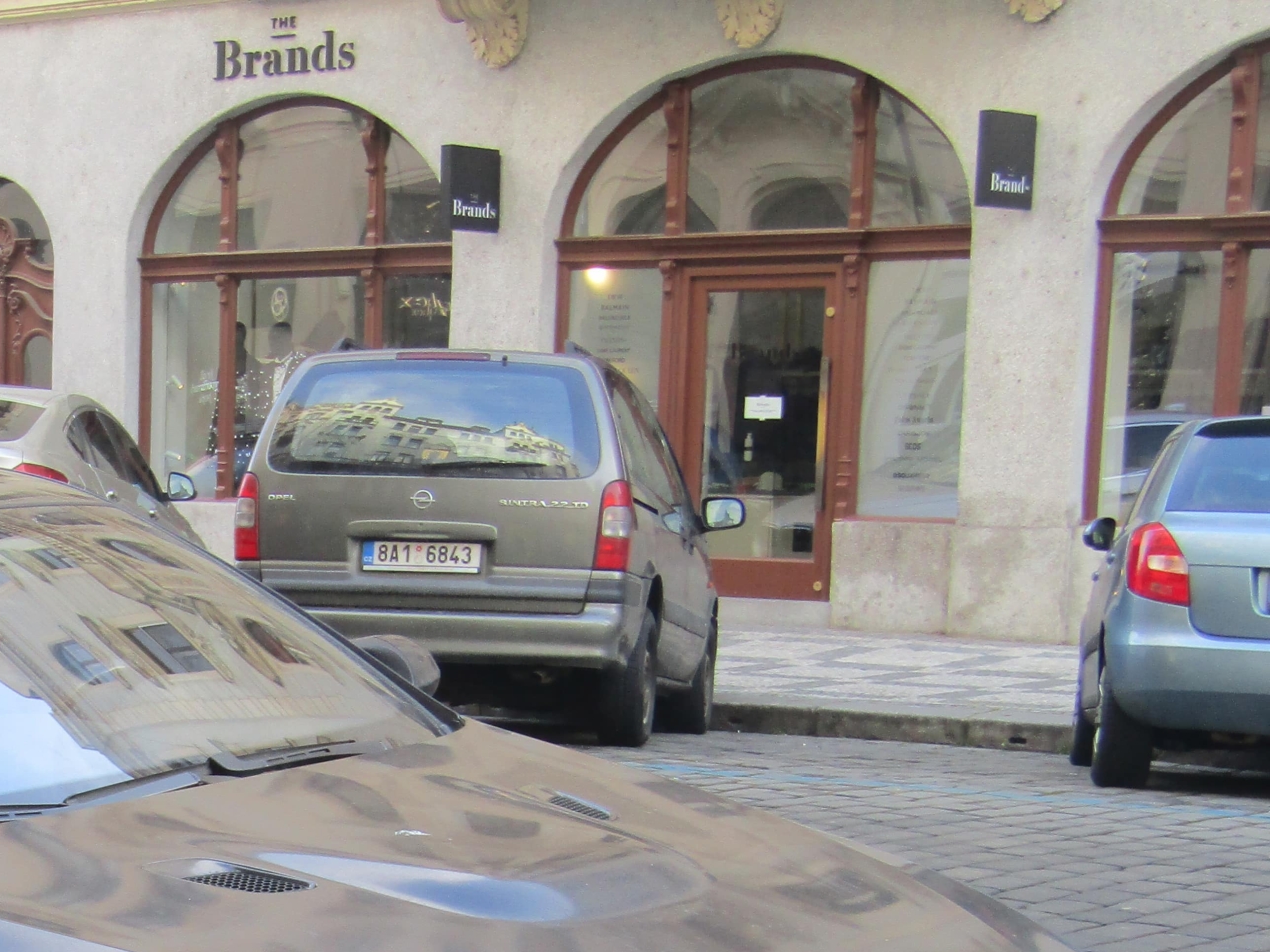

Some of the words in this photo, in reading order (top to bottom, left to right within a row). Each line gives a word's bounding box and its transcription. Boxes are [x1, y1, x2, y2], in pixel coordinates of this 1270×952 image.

[270, 16, 297, 30] THE
[213, 29, 356, 81] Brands
[452, 198, 496, 219] Brands
[498, 499, 546, 507] SINTRA
[377, 544, 411, 563] 8A1
[426, 545, 472, 564] 6843
